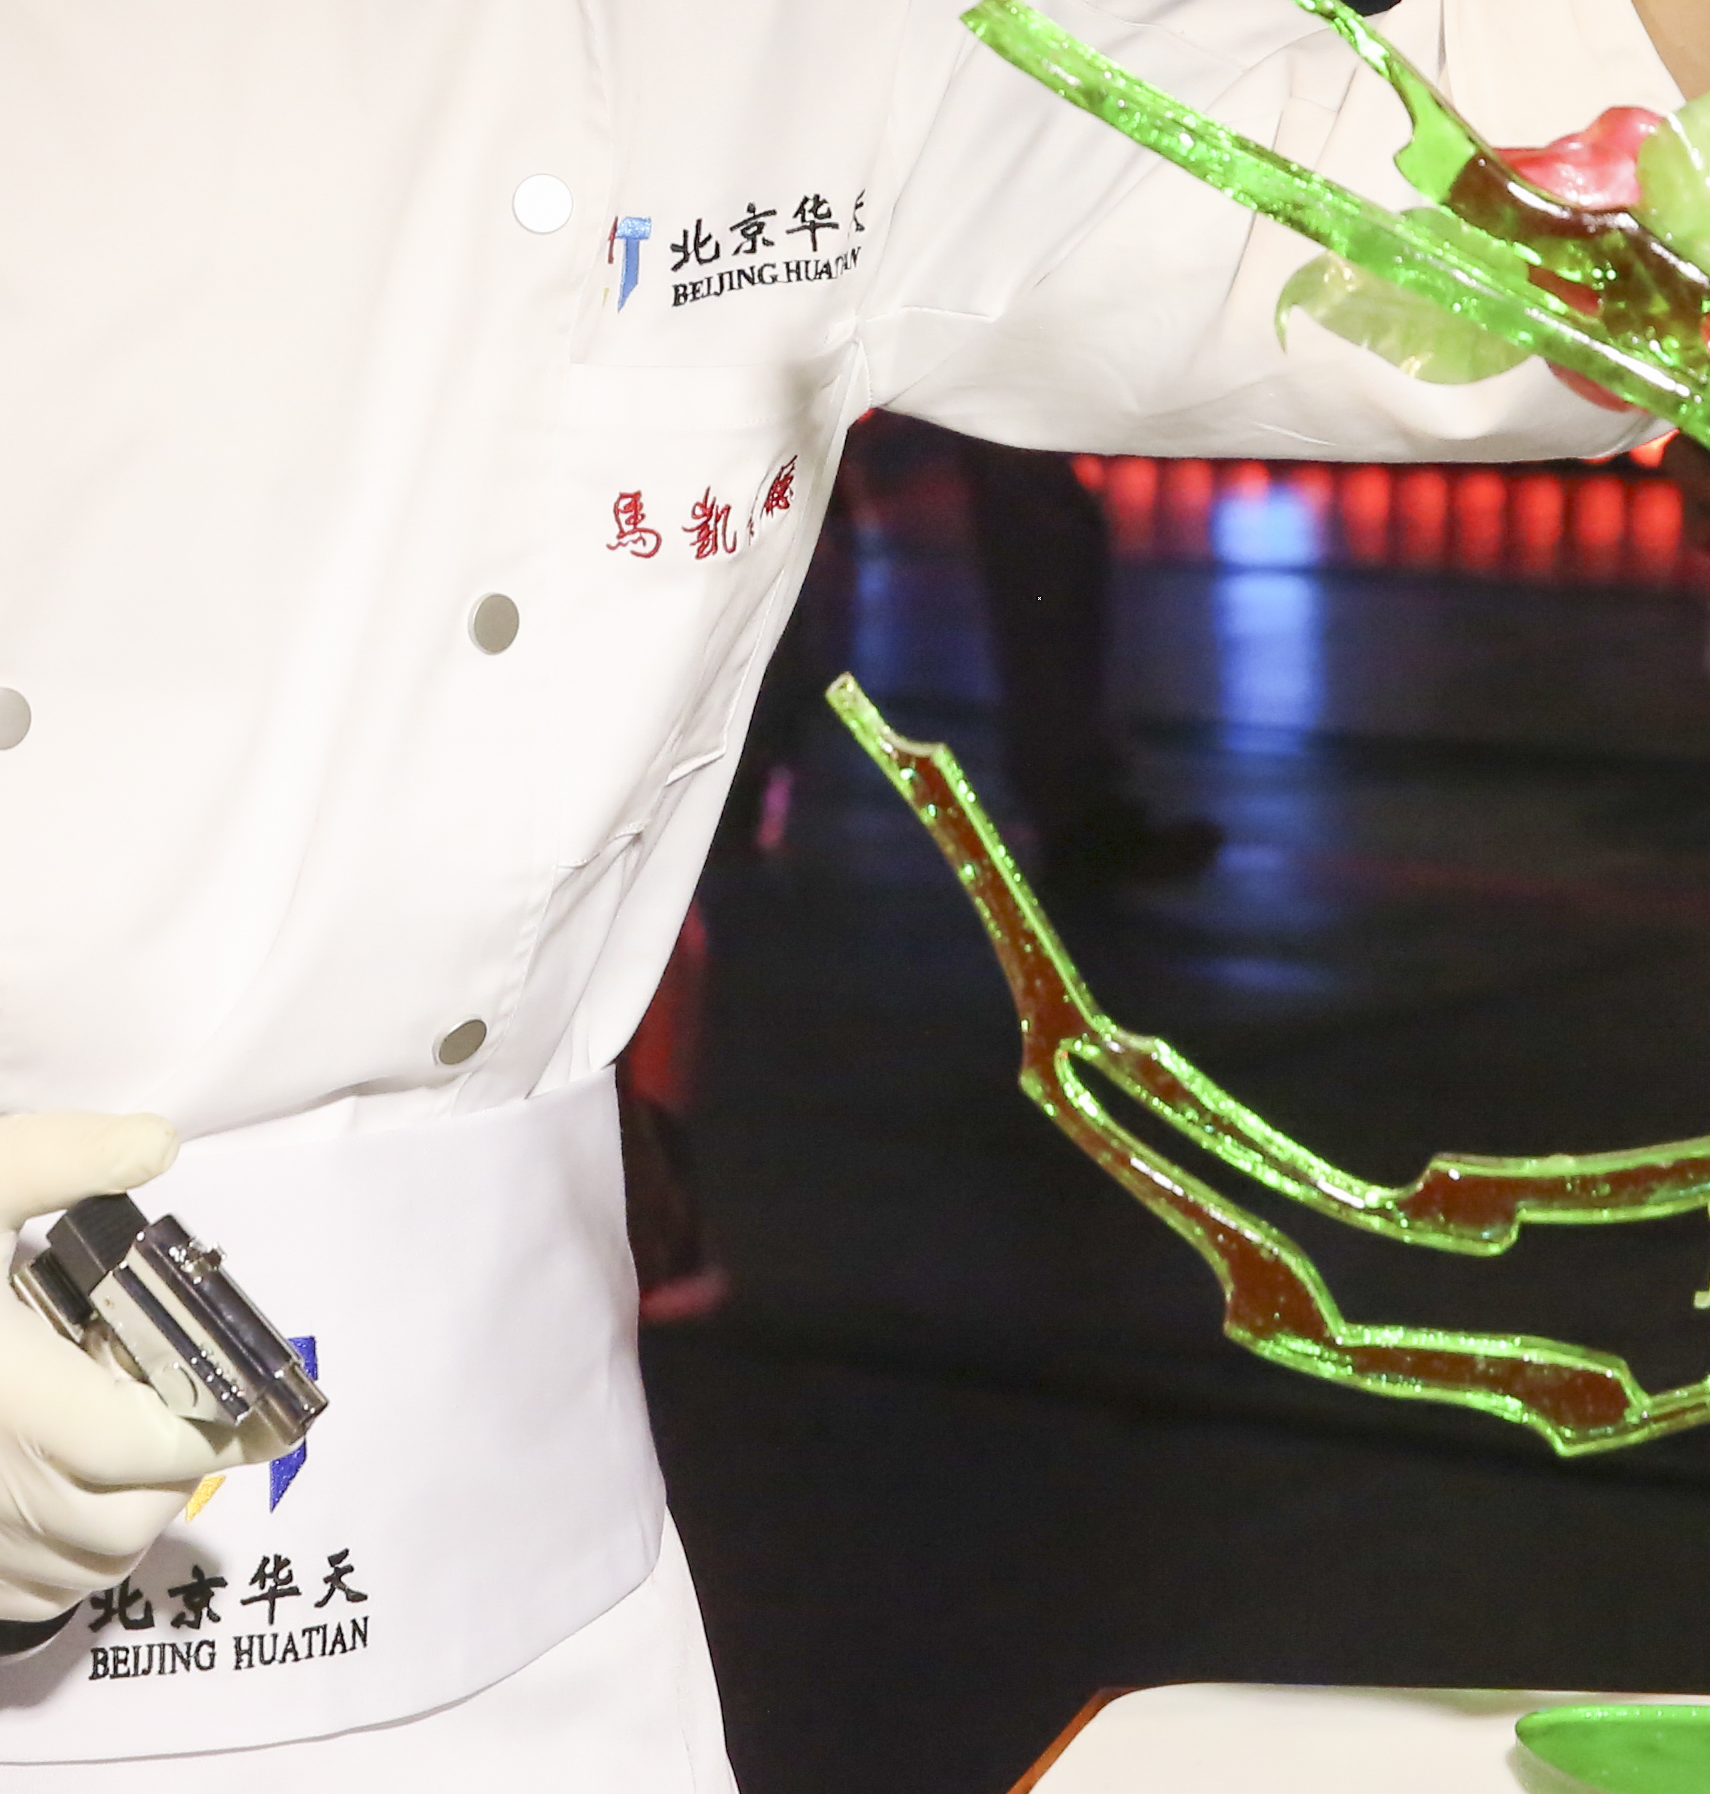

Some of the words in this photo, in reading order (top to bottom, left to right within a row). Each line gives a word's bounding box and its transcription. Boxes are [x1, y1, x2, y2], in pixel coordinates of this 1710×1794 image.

[671, 261, 779, 308] BEIJING
[88, 1548, 369, 1633] 北京华天
[89, 1639, 216, 1681] BEIJING
[233, 1615, 370, 1671] HUATIAN
